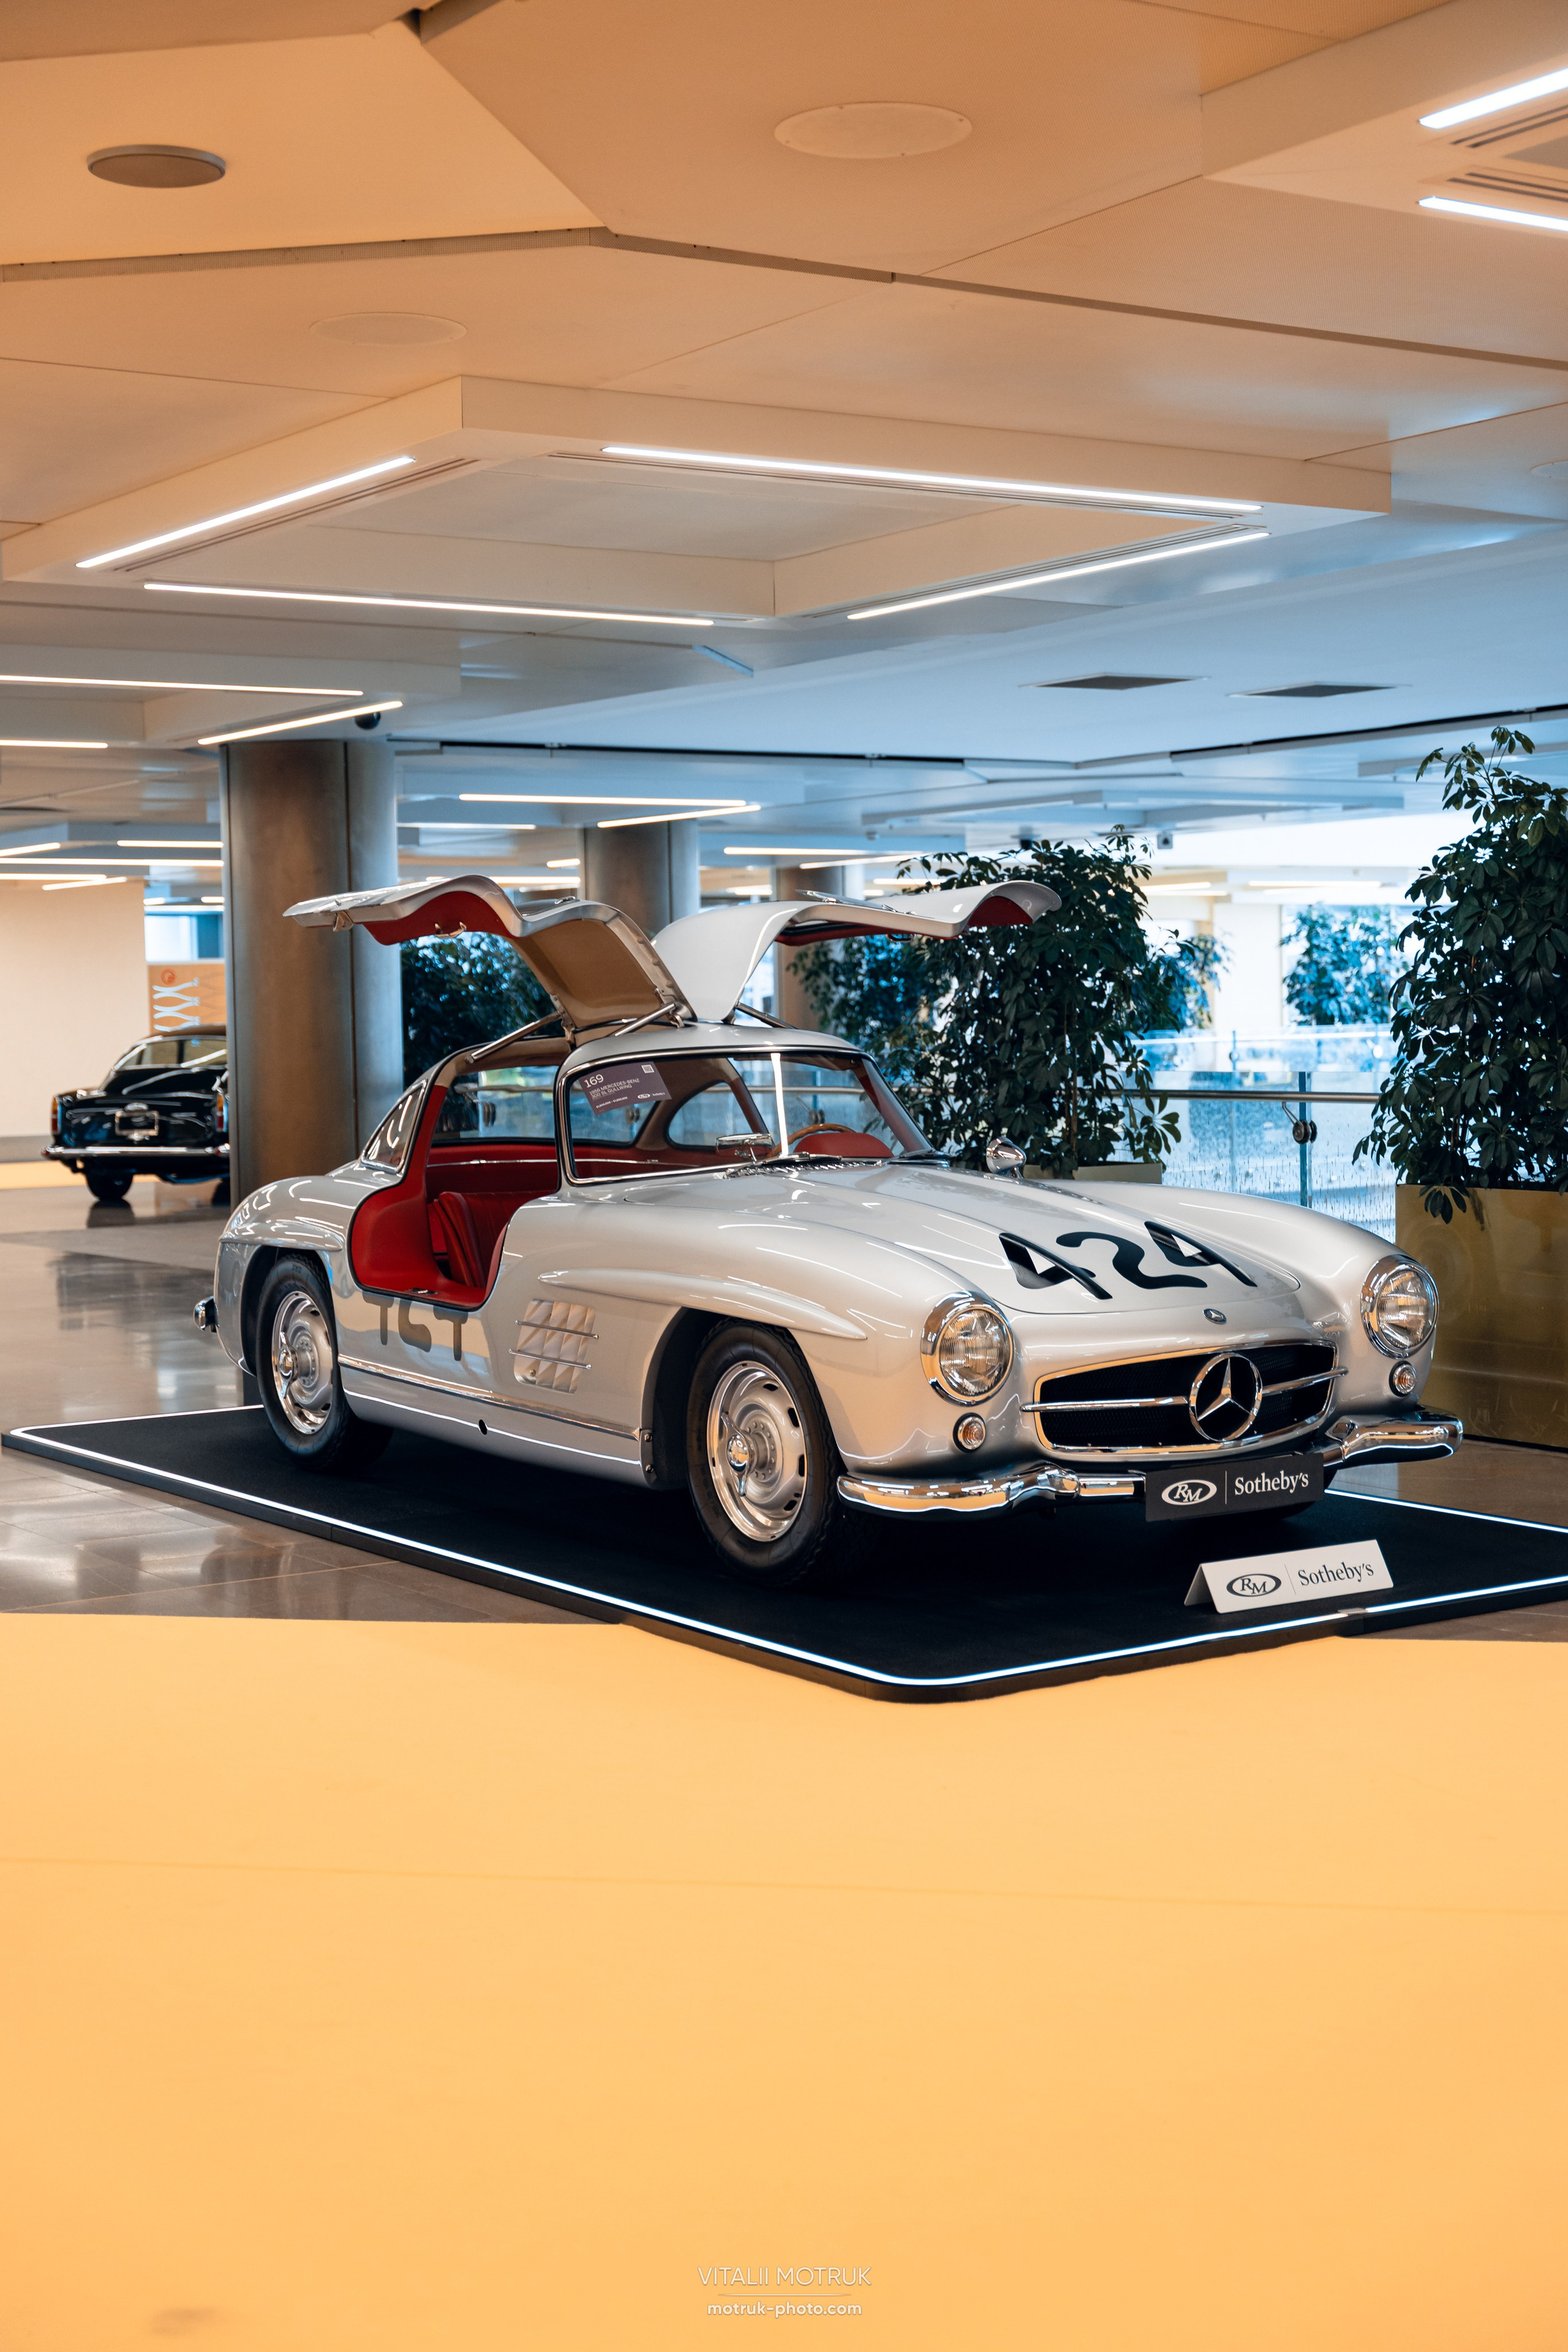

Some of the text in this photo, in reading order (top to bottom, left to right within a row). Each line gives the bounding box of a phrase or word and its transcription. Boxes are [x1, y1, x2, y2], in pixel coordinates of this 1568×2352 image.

[584, 1074, 604, 1088] 169
[601, 1078, 640, 1091] MERCEDES-BENZ
[607, 1084, 633, 1094] GULLWING
[999, 1221, 1258, 1300] 424
[1174, 1470, 1309, 1502] RM Sotheby's
[1240, 1562, 1374, 1594] RM Sotheby's
